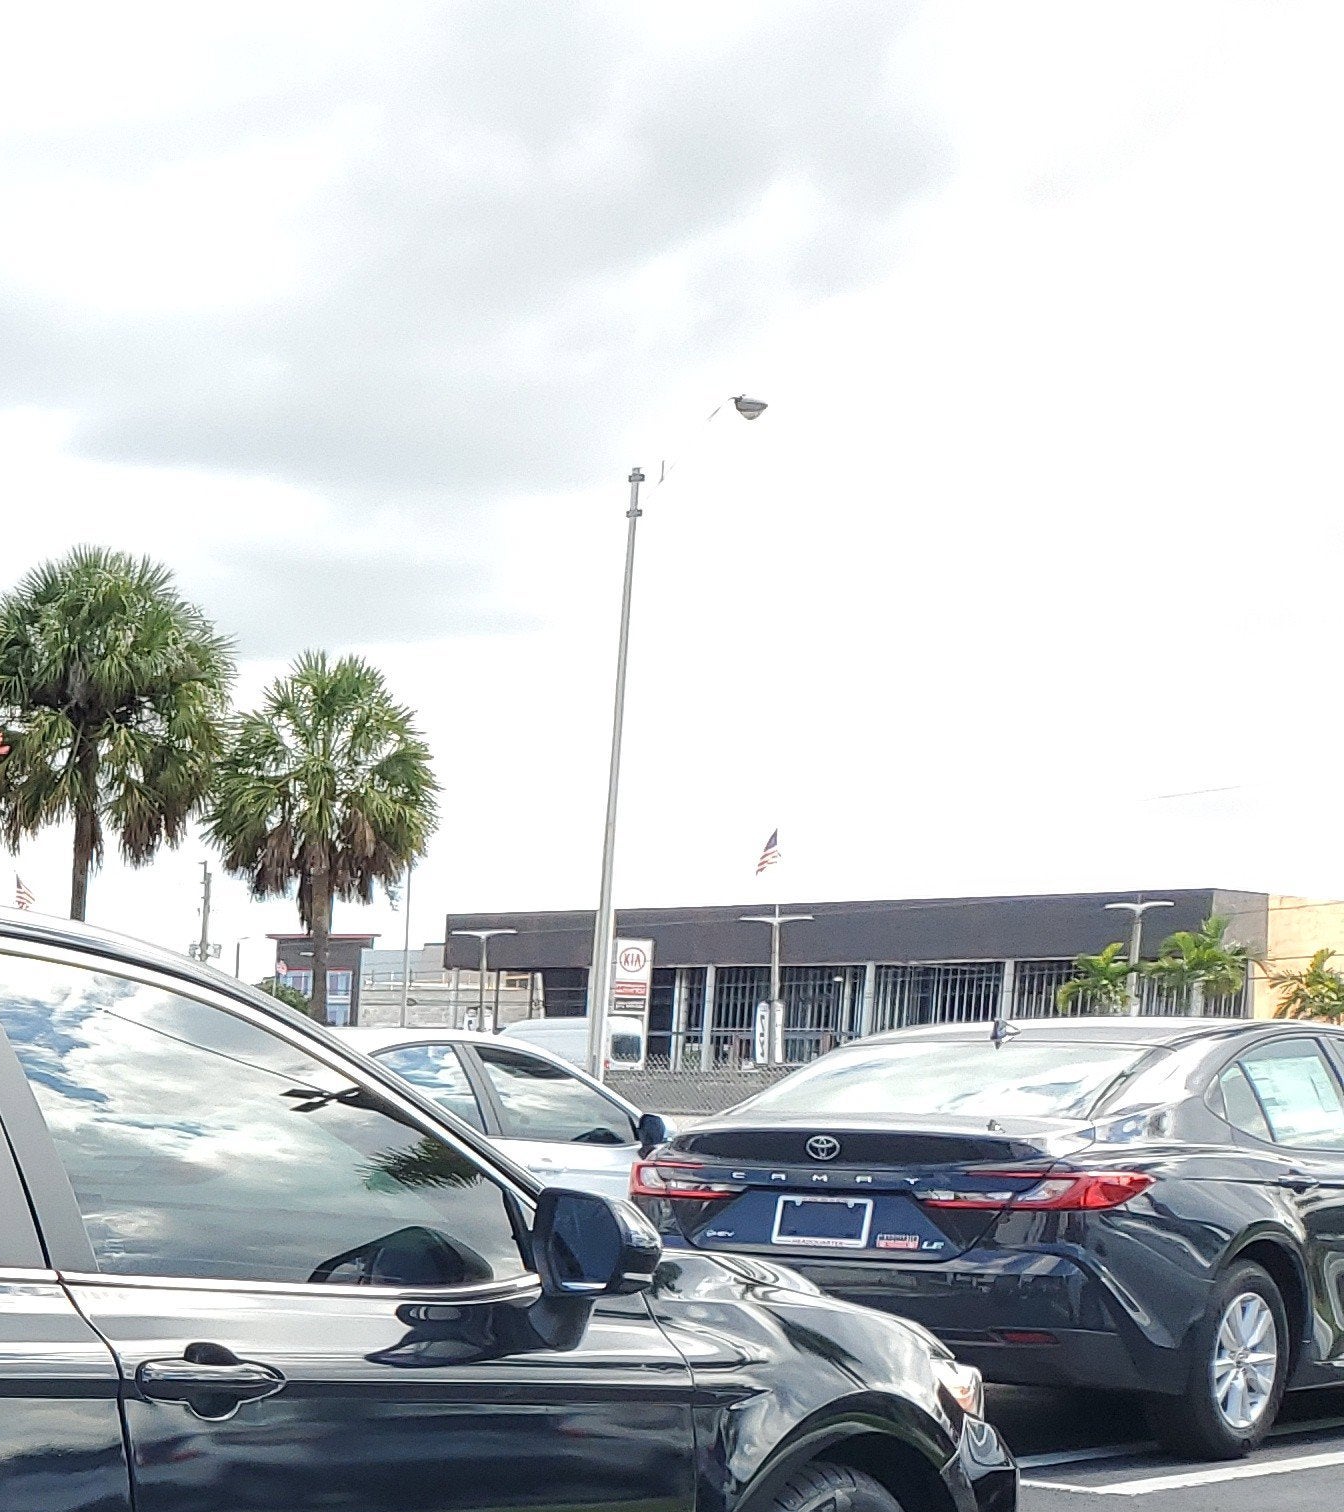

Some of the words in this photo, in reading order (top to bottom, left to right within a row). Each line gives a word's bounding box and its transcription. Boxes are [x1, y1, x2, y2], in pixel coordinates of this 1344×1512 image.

[623, 953, 641, 968] KIA
[732, 1171, 920, 1185] CAMRY
[922, 1240, 945, 1250] LE
